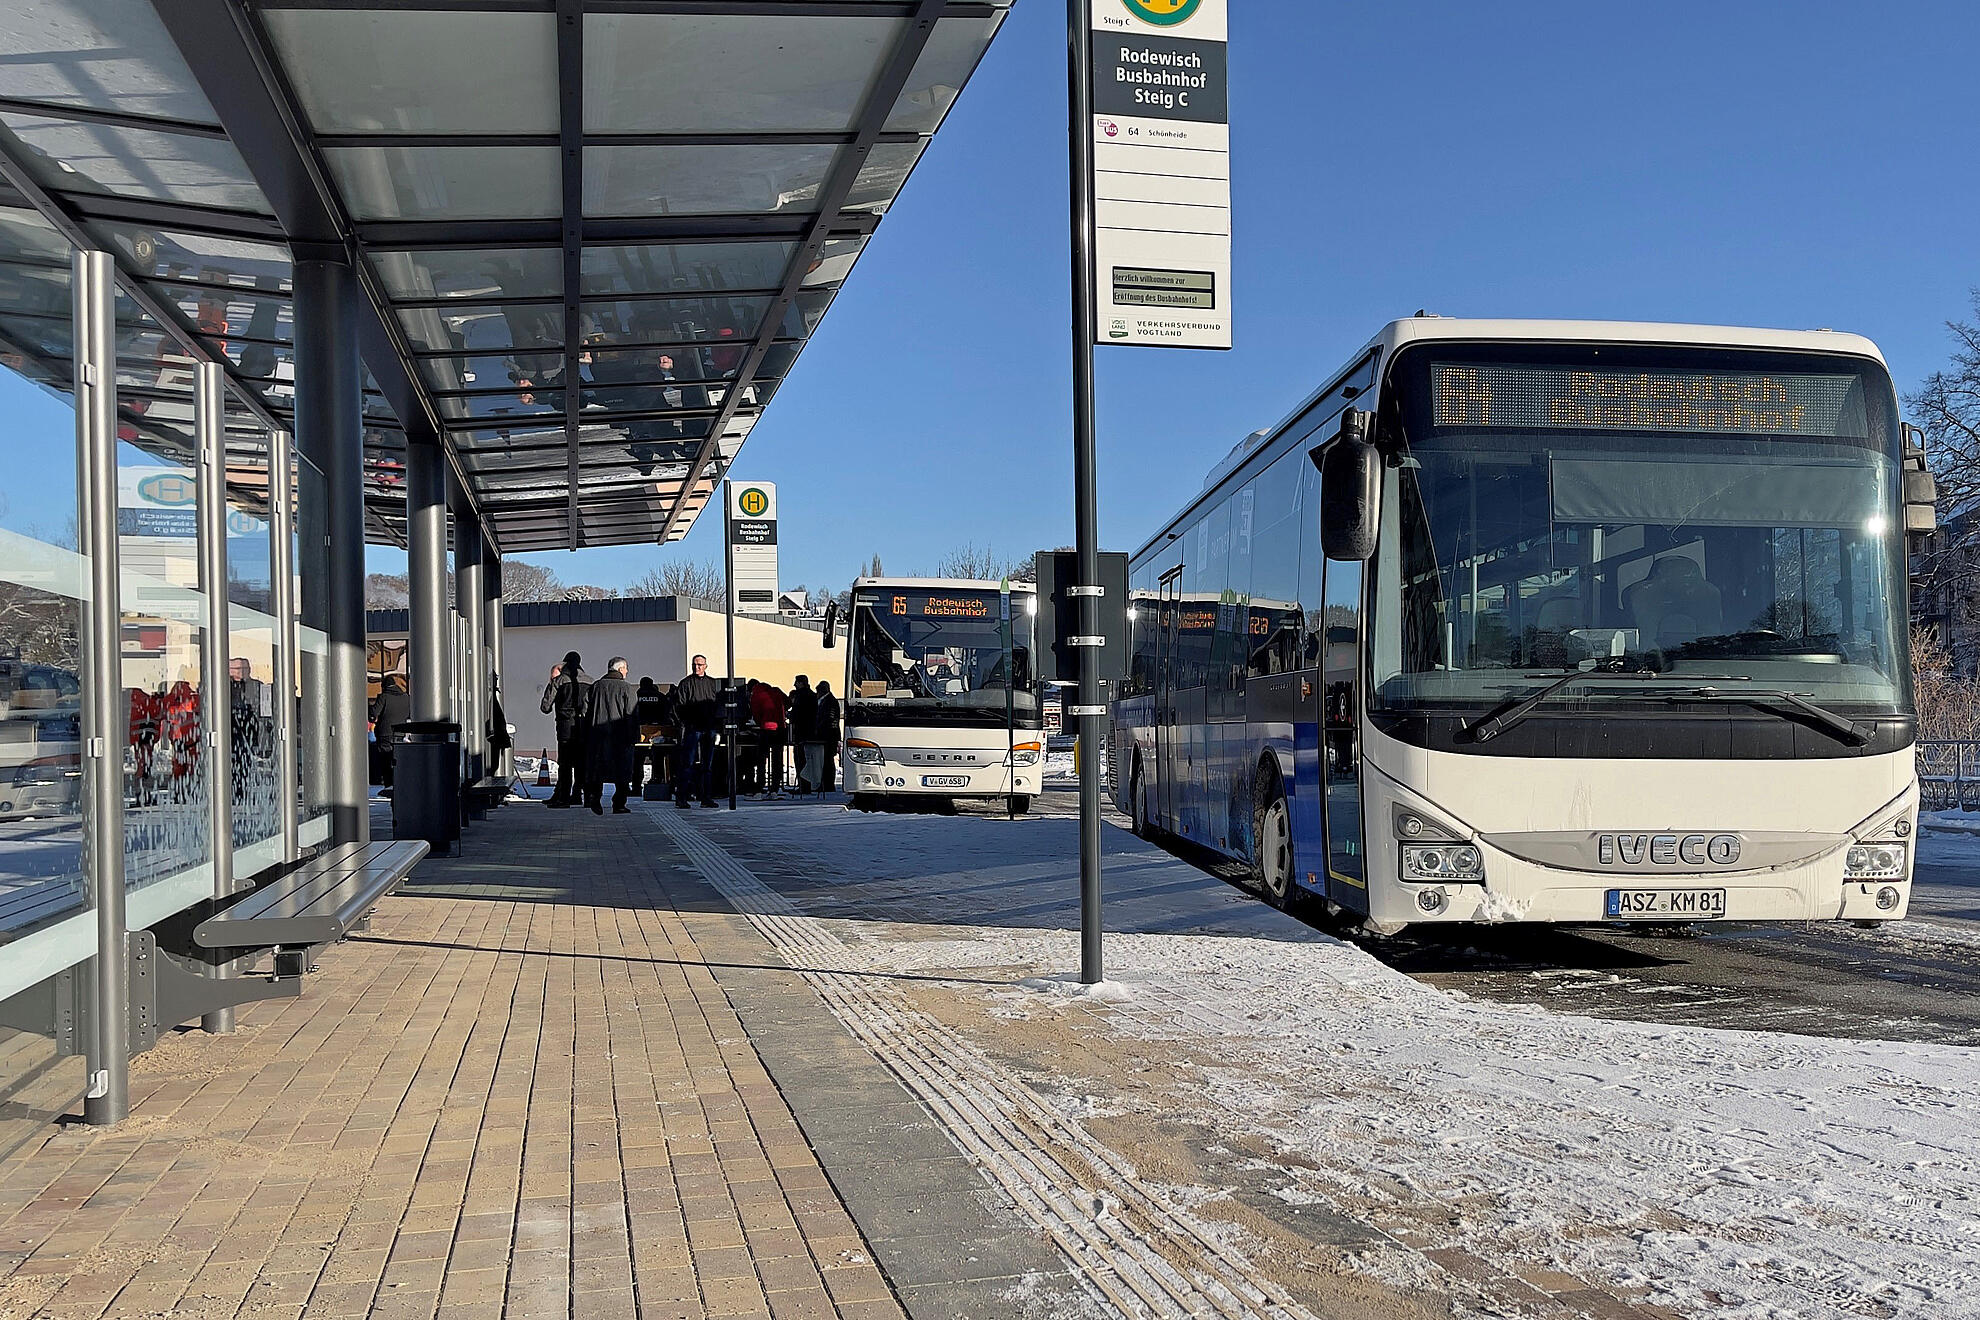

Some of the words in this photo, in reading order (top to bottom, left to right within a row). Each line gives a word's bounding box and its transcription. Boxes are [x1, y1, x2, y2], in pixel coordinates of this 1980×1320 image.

[1103, 16, 1123, 26] Steig
[1125, 18, 1130, 26] C
[1120, 47, 1201, 68] Rodewisch
[1116, 66, 1207, 89] Busbahnhof
[1135, 88, 1174, 109] Steig
[1178, 91, 1188, 107] C
[1128, 127, 1139, 136] 64
[1148, 129, 1188, 139] Schönheide
[1114, 273, 1138, 282] Herzlich
[1140, 275, 1175, 285] willkommen
[1114, 291, 1144, 303] Eröffnung
[1145, 294, 1156, 302] des
[1137, 321, 1221, 330] VERKEHRSVERBUND
[1570, 371, 1787, 402] Rodewisch
[1442, 368, 1493, 425] 64
[1550, 398, 1805, 431] Busbahnhof
[892, 596, 907, 615] 65
[928, 597, 983, 608] Rodewisch
[923, 605, 988, 616] Busbahnhof
[912, 753, 976, 761] SETRA
[929, 777, 935, 785] V
[1598, 834, 1742, 865] IVECO
[1620, 892, 1658, 912] ASZ
[1670, 892, 1696, 911] KM
[1699, 892, 1722, 911] 81
